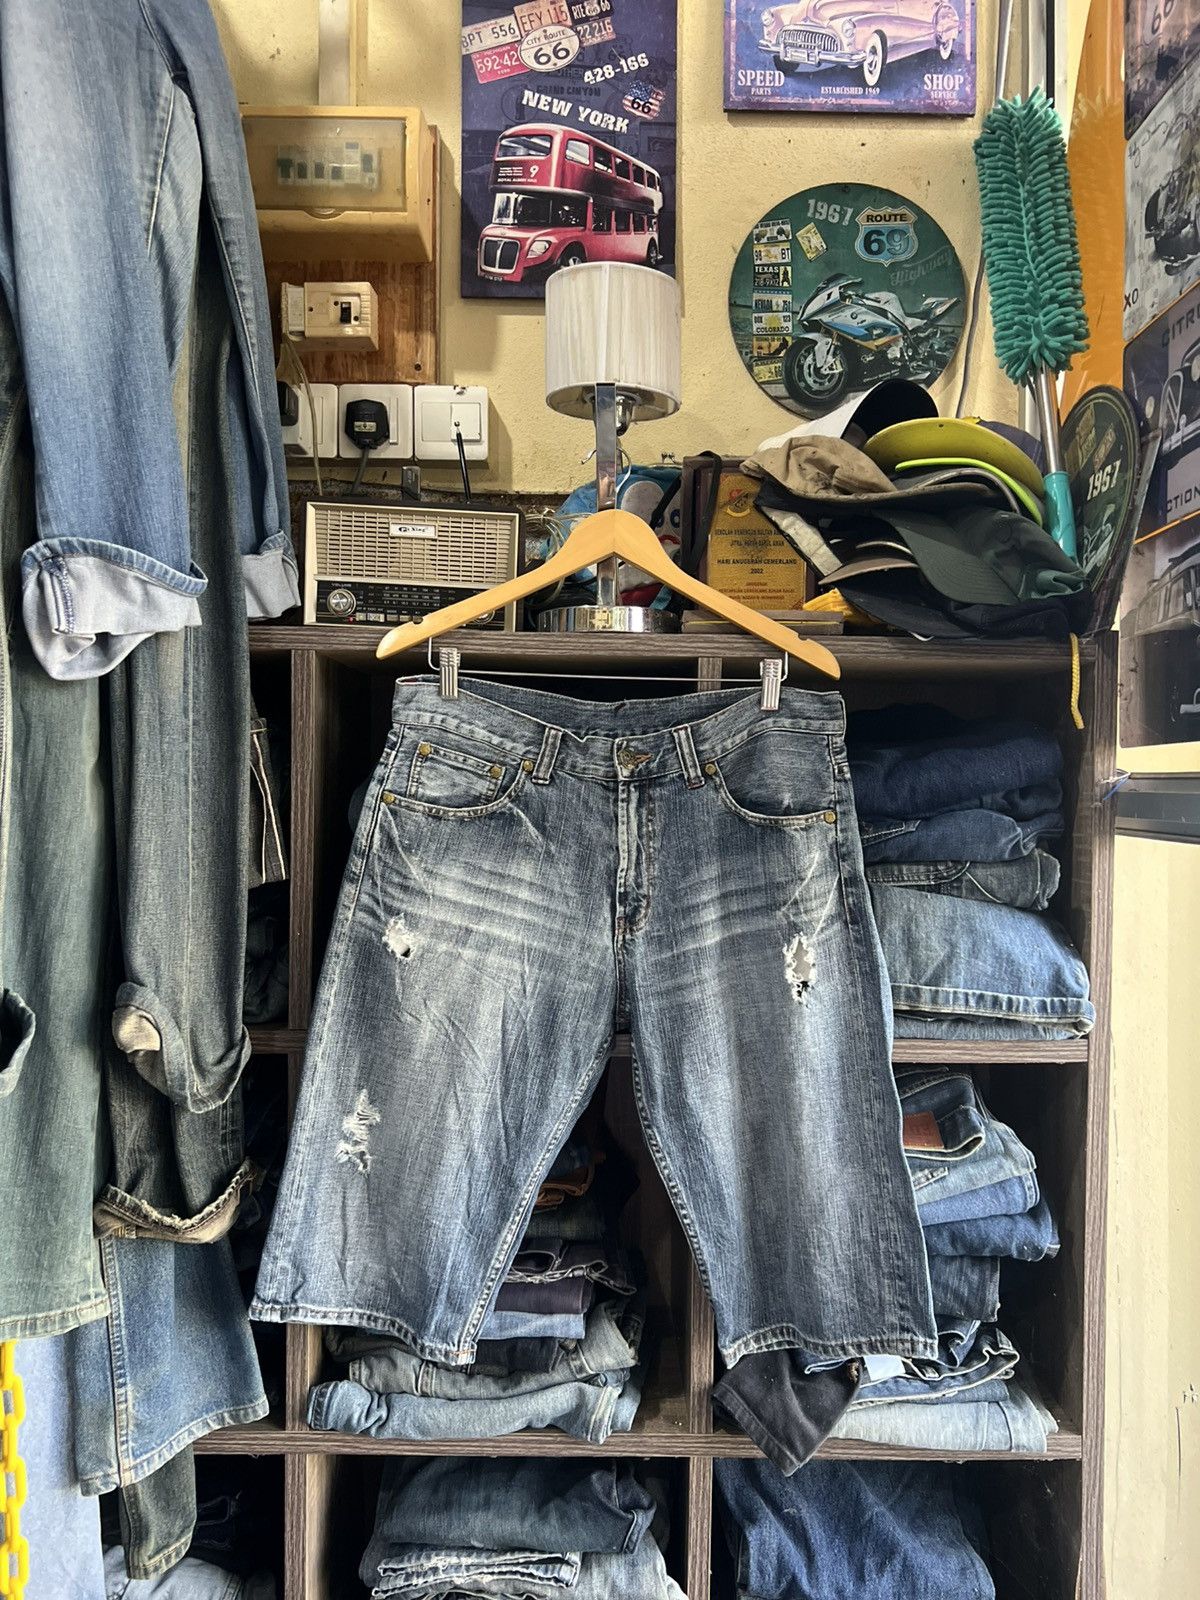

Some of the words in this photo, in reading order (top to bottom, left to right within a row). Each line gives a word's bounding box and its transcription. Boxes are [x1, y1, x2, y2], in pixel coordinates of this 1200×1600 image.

[491, 23, 516, 39] 556
[520, 10, 543, 32] EFY
[526, 36, 541, 46] CITY
[545, 30, 566, 40] ROUTE
[533, 42, 570, 65] 66
[584, 53, 649, 84] 428-166
[738, 70, 785, 86] SPEED
[924, 74, 963, 90] SHOP
[821, 86, 863, 95] ESTABLISHED
[522, 90, 573, 117] NEW
[578, 106, 630, 133] YORK
[631, 97, 653, 114] 66
[530, 165, 539, 177] 9
[807, 199, 853, 226] 1967
[866, 213, 908, 222] ROUTE
[864, 228, 910, 256] 69
[1087, 459, 1121, 500] 1967
